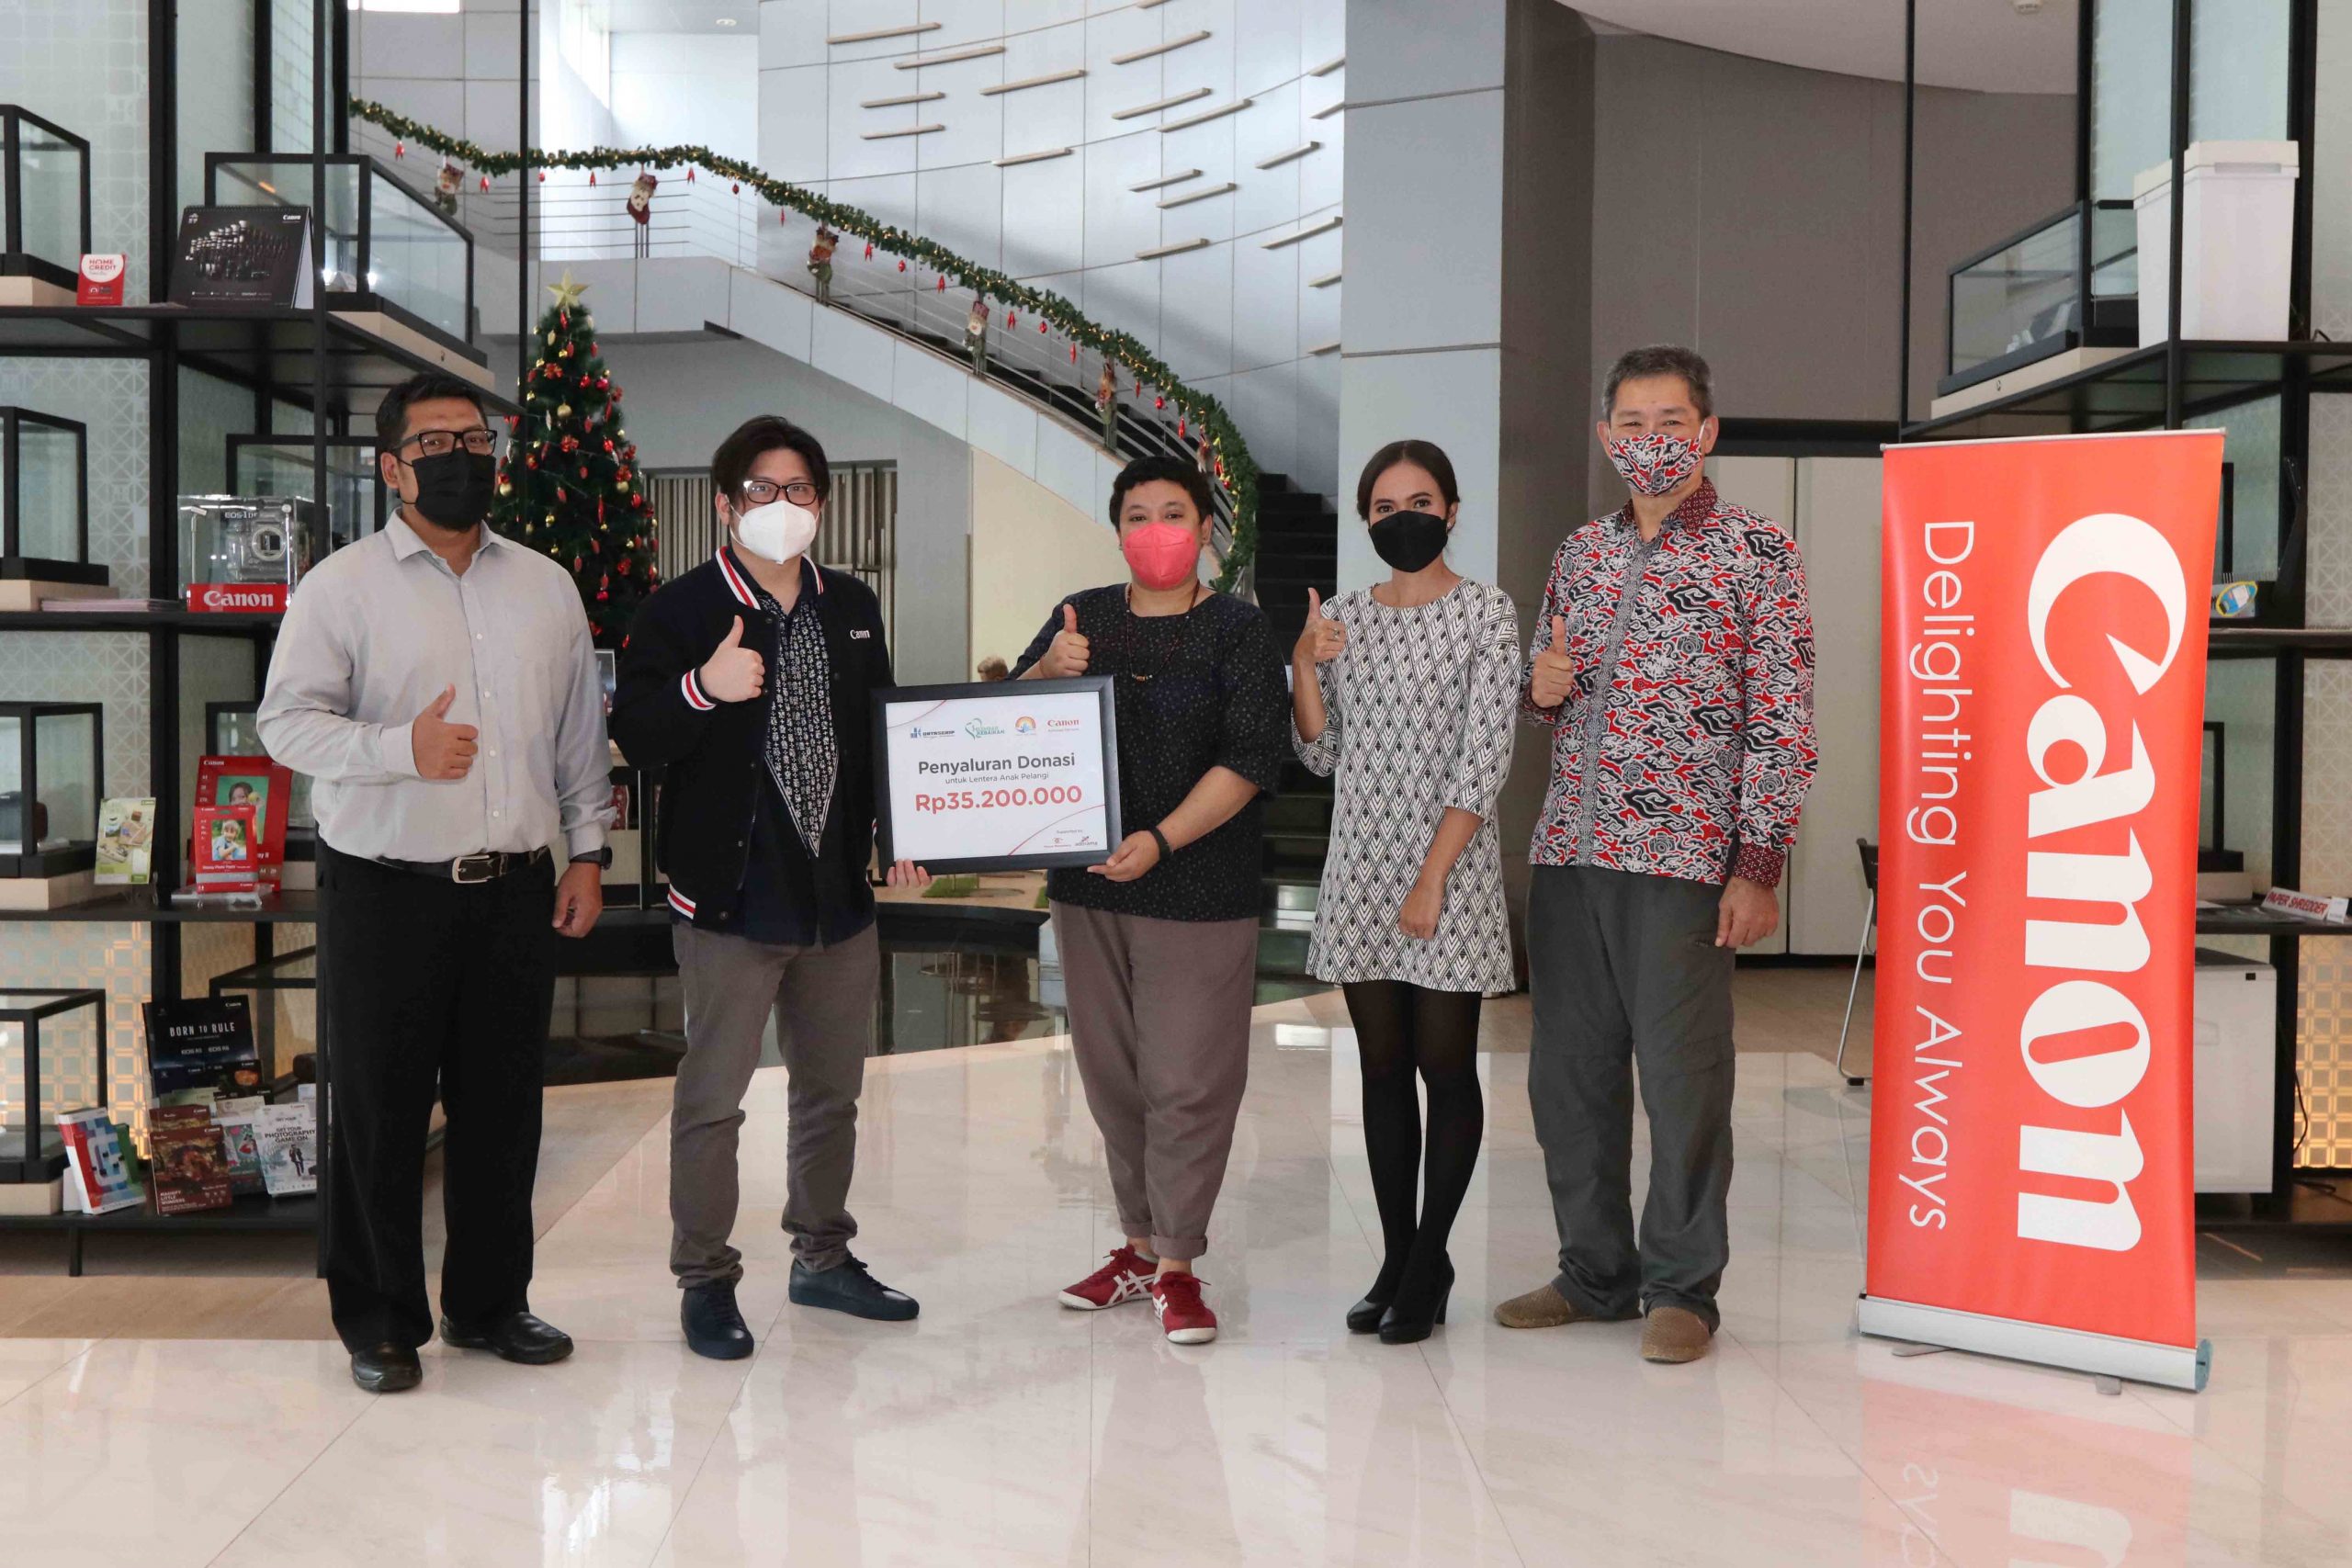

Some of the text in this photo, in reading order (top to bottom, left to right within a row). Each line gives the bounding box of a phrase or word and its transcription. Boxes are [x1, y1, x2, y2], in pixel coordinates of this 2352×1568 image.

[204, 590, 274, 607] Canon
[1046, 718, 1080, 728] Canon
[918, 752, 1076, 775] Penyaluran Donasi
[945, 776, 967, 784] untuk
[1021, 772, 1049, 780] Pelangi
[915, 785, 1082, 815] Rp35.200.000
[1898, 521, 1975, 1230] Delighting You Always
[2018, 513, 2188, 1252] Canon
[2289, 897, 2329, 915] SHREDDER
[169, 1025, 195, 1037] BORN
[211, 1021, 235, 1033] RULE
[264, 1129, 316, 1138] PHOTOGRAPHY
